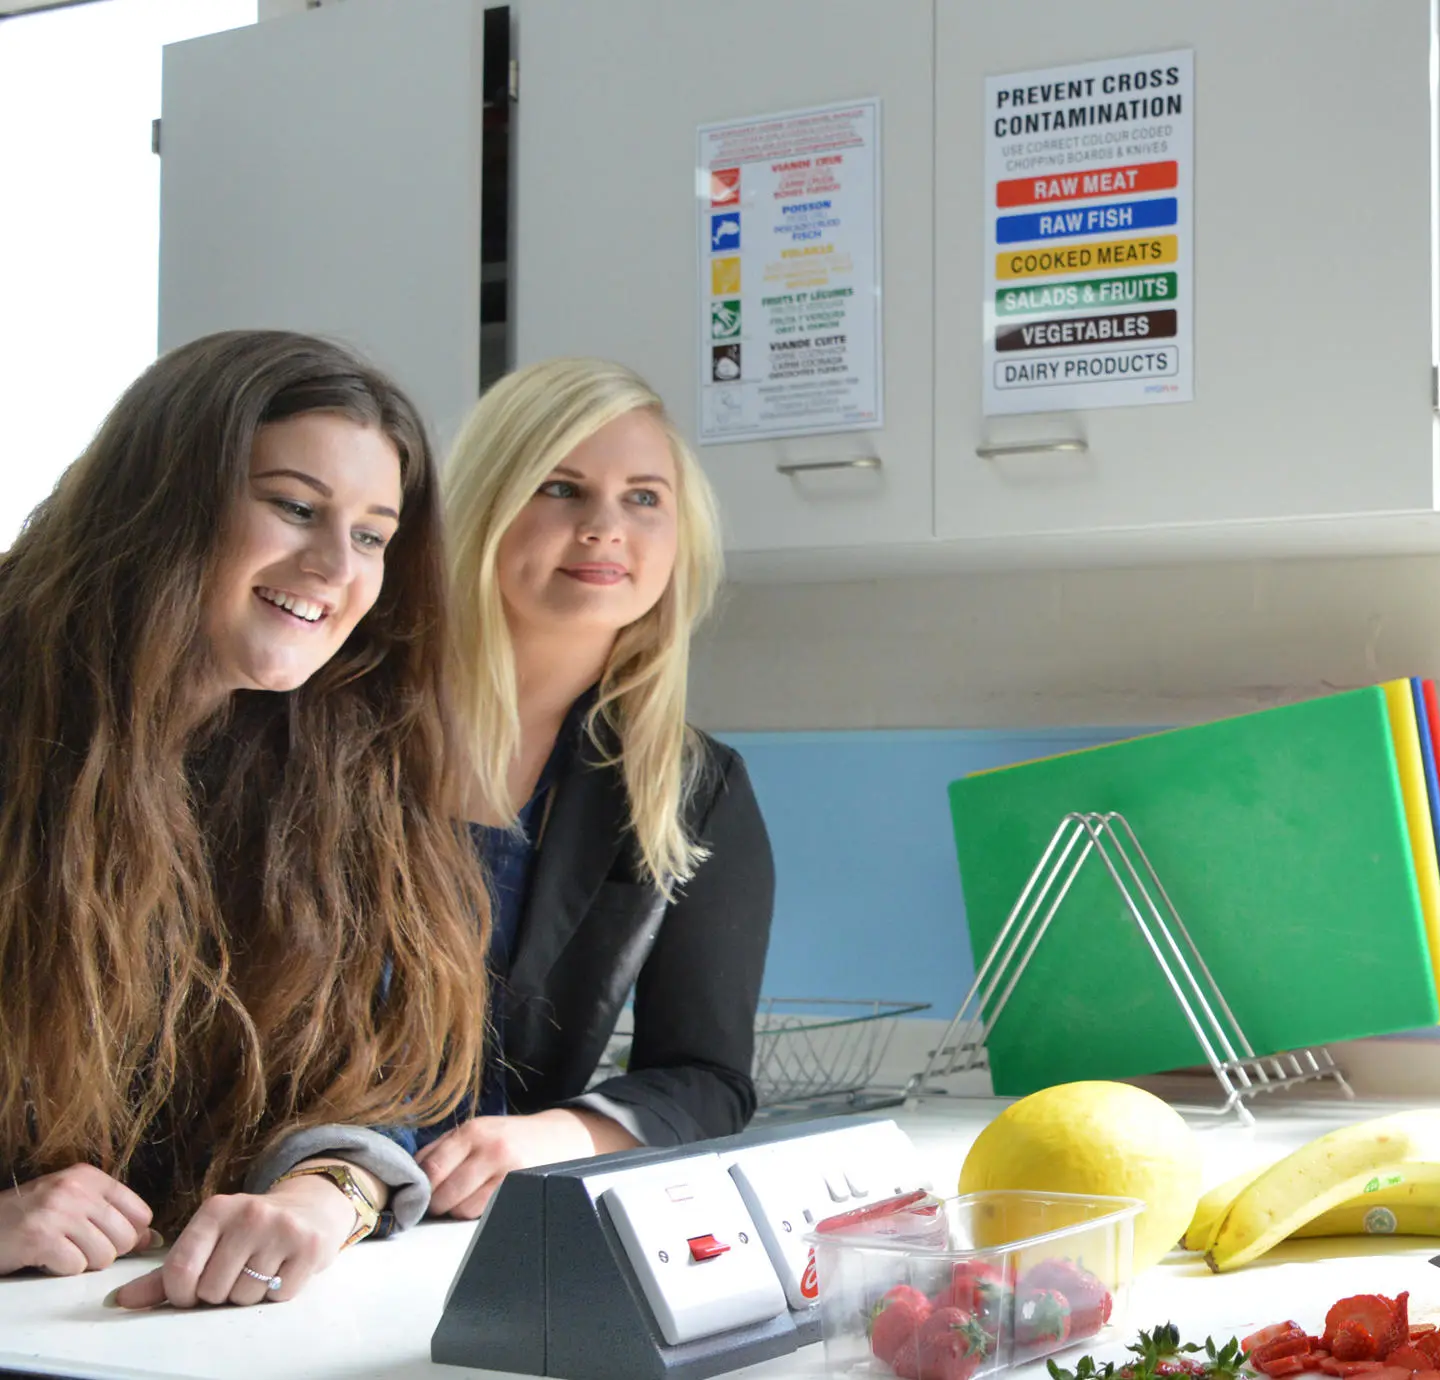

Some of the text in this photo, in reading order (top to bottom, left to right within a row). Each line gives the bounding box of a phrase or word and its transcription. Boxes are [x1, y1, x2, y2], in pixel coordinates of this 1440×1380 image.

[996, 67, 1180, 109] PREVENT CROSS
[995, 94, 1183, 138] CONTAMINATION
[1001, 124, 1173, 157] USE CORRECT COLOUR CODED
[1006, 140, 1168, 172] CHOPPING BOARDS & KNIVES
[1033, 169, 1139, 200] RAW MEAT
[782, 200, 832, 214] POISSON
[1039, 207, 1134, 235] RAW FISH
[792, 230, 822, 241] FISCH
[1010, 240, 1162, 274] COOKED MEATS
[1004, 277, 1168, 311] SALADS & FRUITS
[769, 334, 848, 352] VIANDE CUITE
[1021, 315, 1150, 346] VEGETABLES
[1005, 352, 1168, 383] DAIRY PRODUCTS
